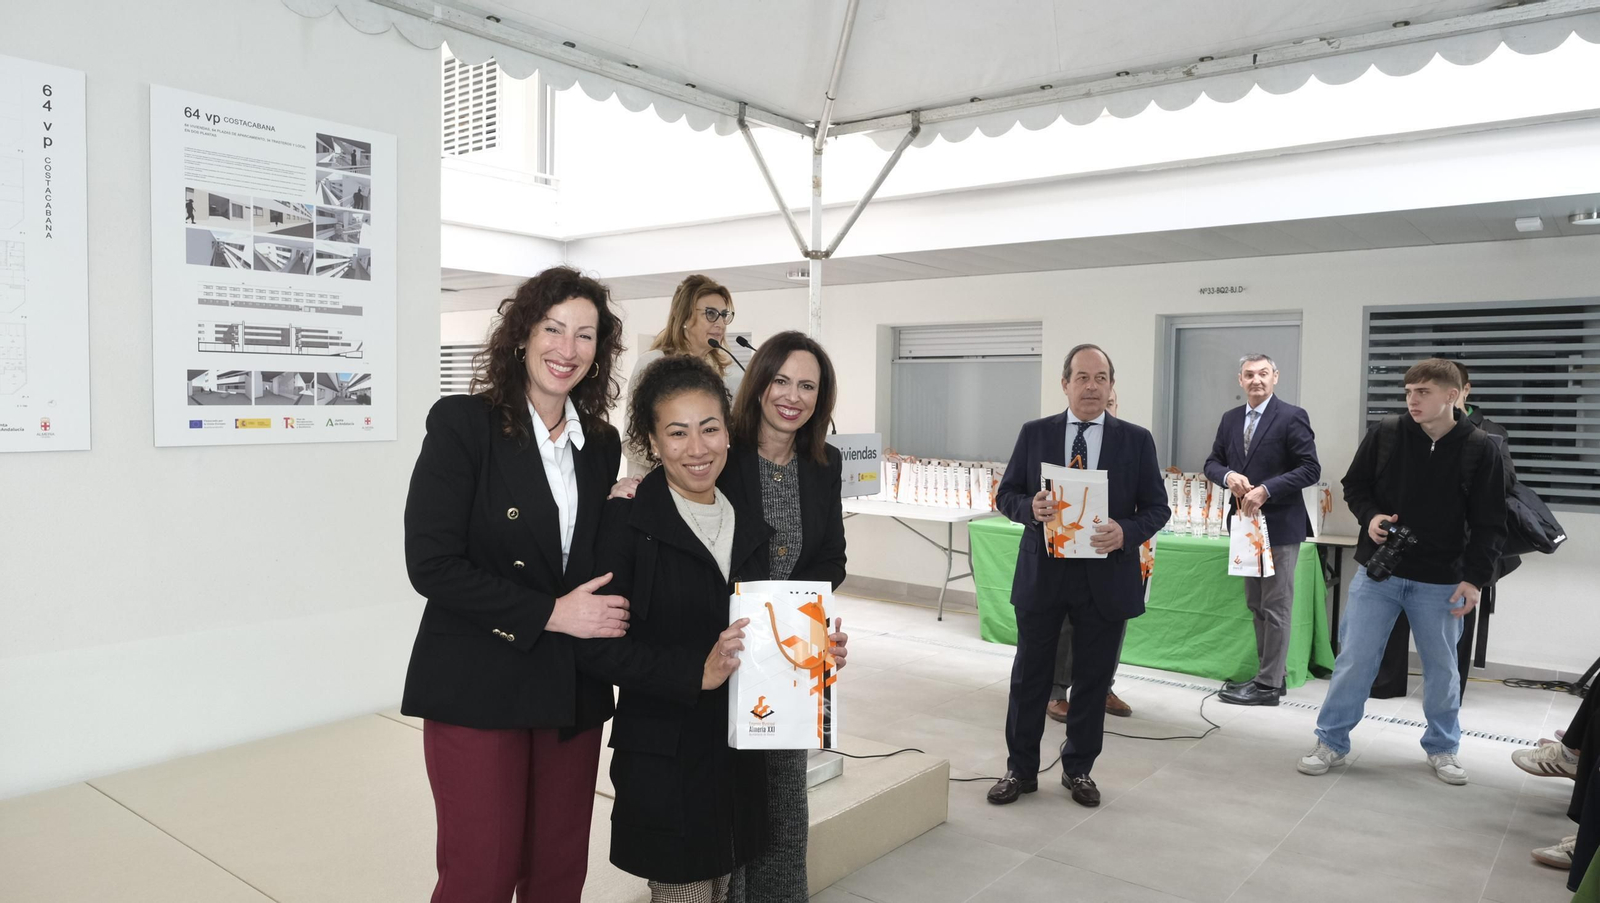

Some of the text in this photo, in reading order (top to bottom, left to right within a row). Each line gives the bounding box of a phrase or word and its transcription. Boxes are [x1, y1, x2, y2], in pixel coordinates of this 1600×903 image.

[42, 84, 53, 112] 64
[184, 106, 276, 132] 64 vp COSTACABANA
[841, 445, 877, 461] iviendas
